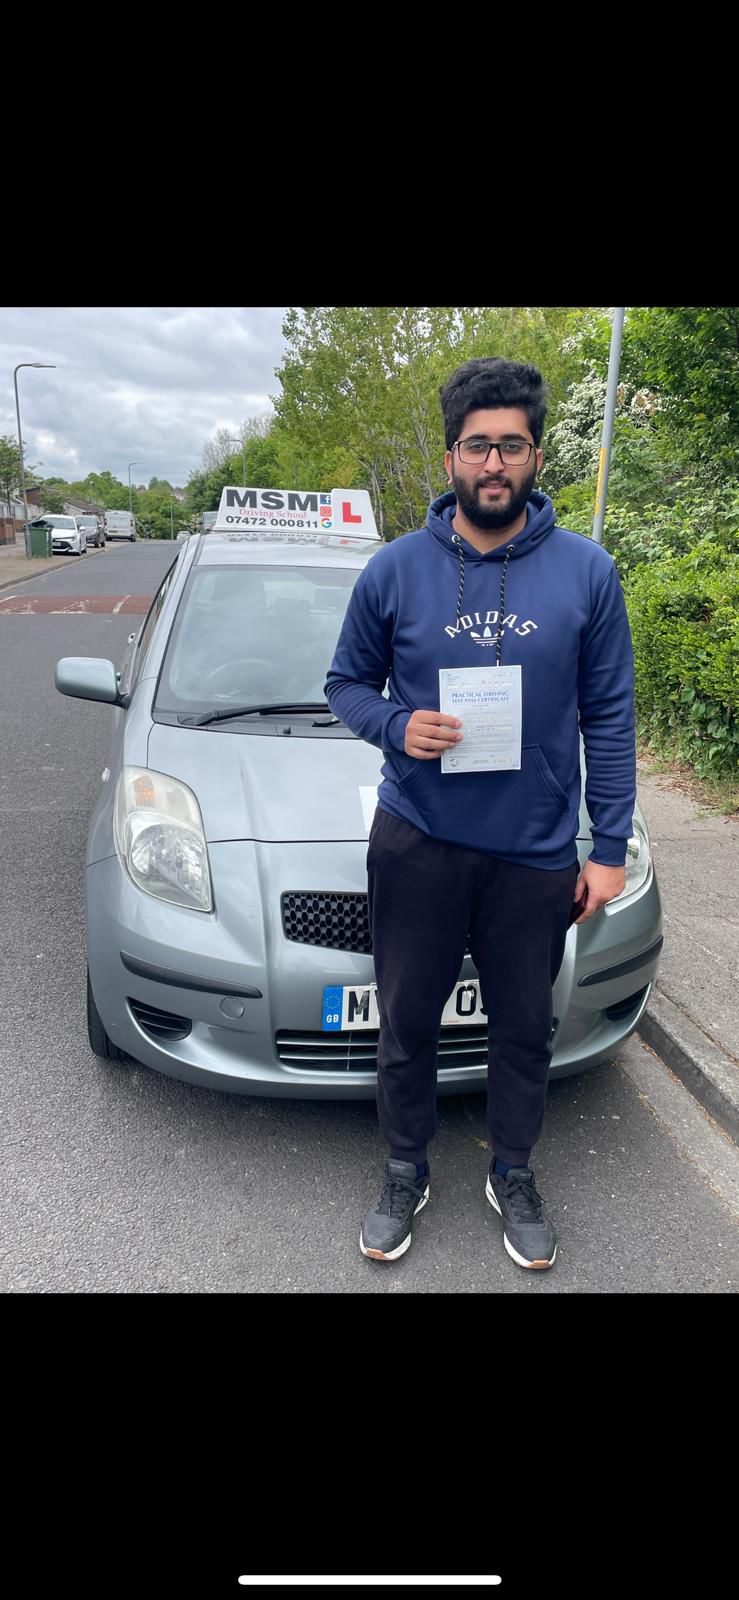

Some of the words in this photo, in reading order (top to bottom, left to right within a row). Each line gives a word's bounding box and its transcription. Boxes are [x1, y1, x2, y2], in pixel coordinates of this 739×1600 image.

[226, 489, 318, 512] MSM
[239, 508, 274, 518] Driving
[276, 510, 307, 519] School
[342, 502, 362, 523] L
[225, 515, 267, 526] 07472
[270, 518, 318, 528] 000811
[444, 611, 538, 638] ADIDAS
[326, 1014, 339, 1023] GB
